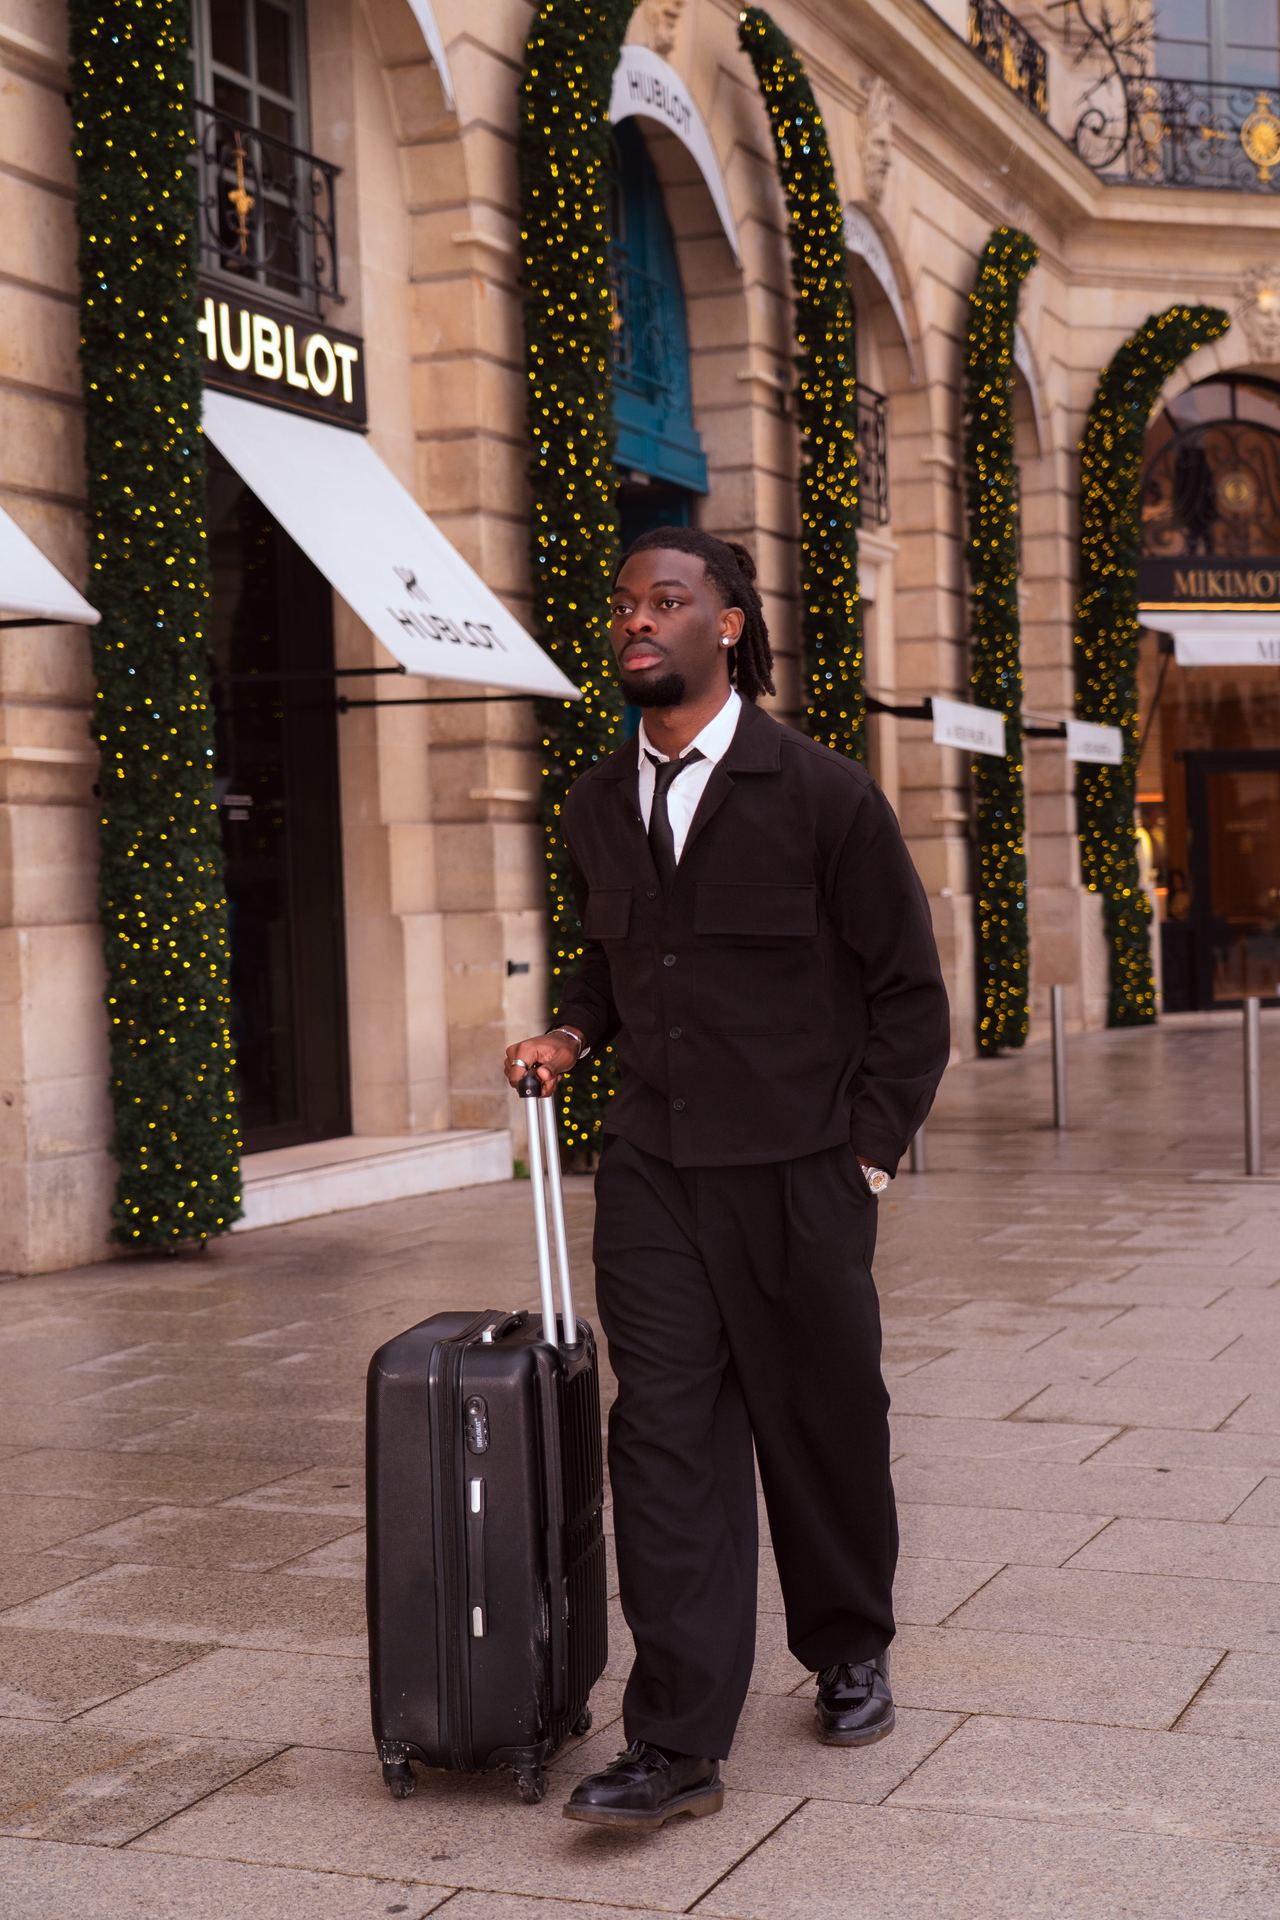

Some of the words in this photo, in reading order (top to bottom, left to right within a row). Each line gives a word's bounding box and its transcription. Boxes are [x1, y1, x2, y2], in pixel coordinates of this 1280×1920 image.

[627, 70, 691, 136] HUBLOT
[197, 297, 358, 404] HUBLOT
[386, 606, 508, 653] HUBLOT
